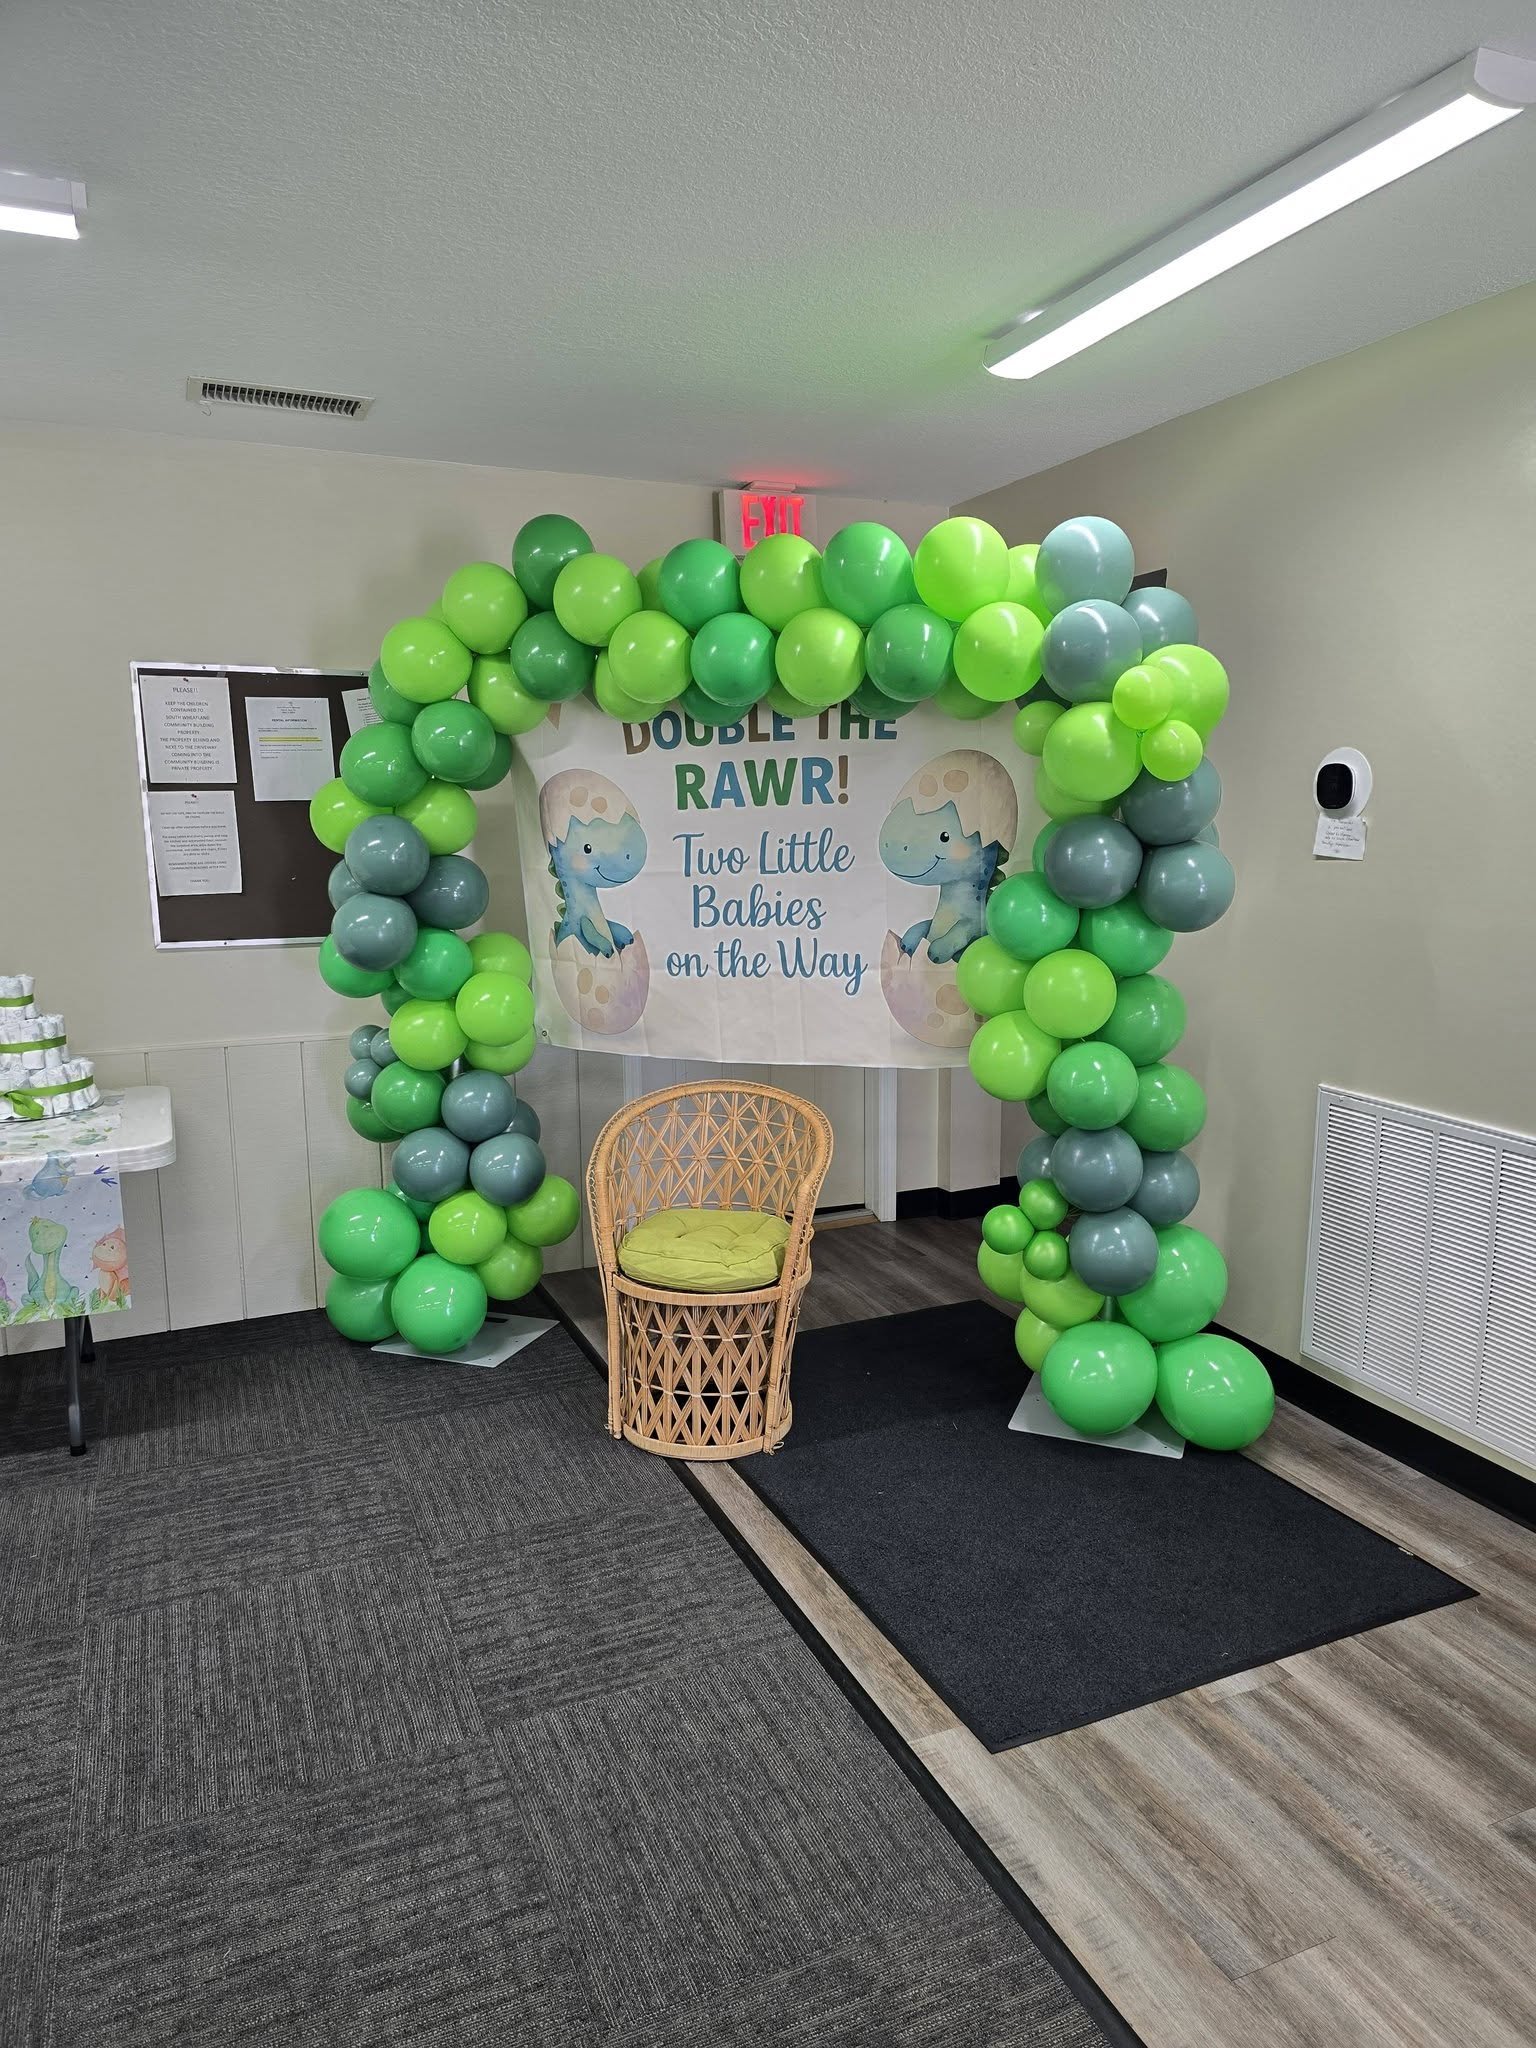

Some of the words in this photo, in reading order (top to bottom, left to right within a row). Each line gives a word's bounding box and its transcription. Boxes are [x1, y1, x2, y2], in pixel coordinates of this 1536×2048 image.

[742, 494, 804, 549] EXIT
[622, 702, 795, 755] DOUBLE
[817, 699, 898, 740] THE
[675, 755, 849, 810] RAWR!
[672, 832, 750, 877] Two
[759, 827, 856, 875] Little
[692, 883, 827, 930] Babies
[666, 952, 709, 978] on
[713, 938, 771, 979] the
[776, 936, 868, 996] Way
